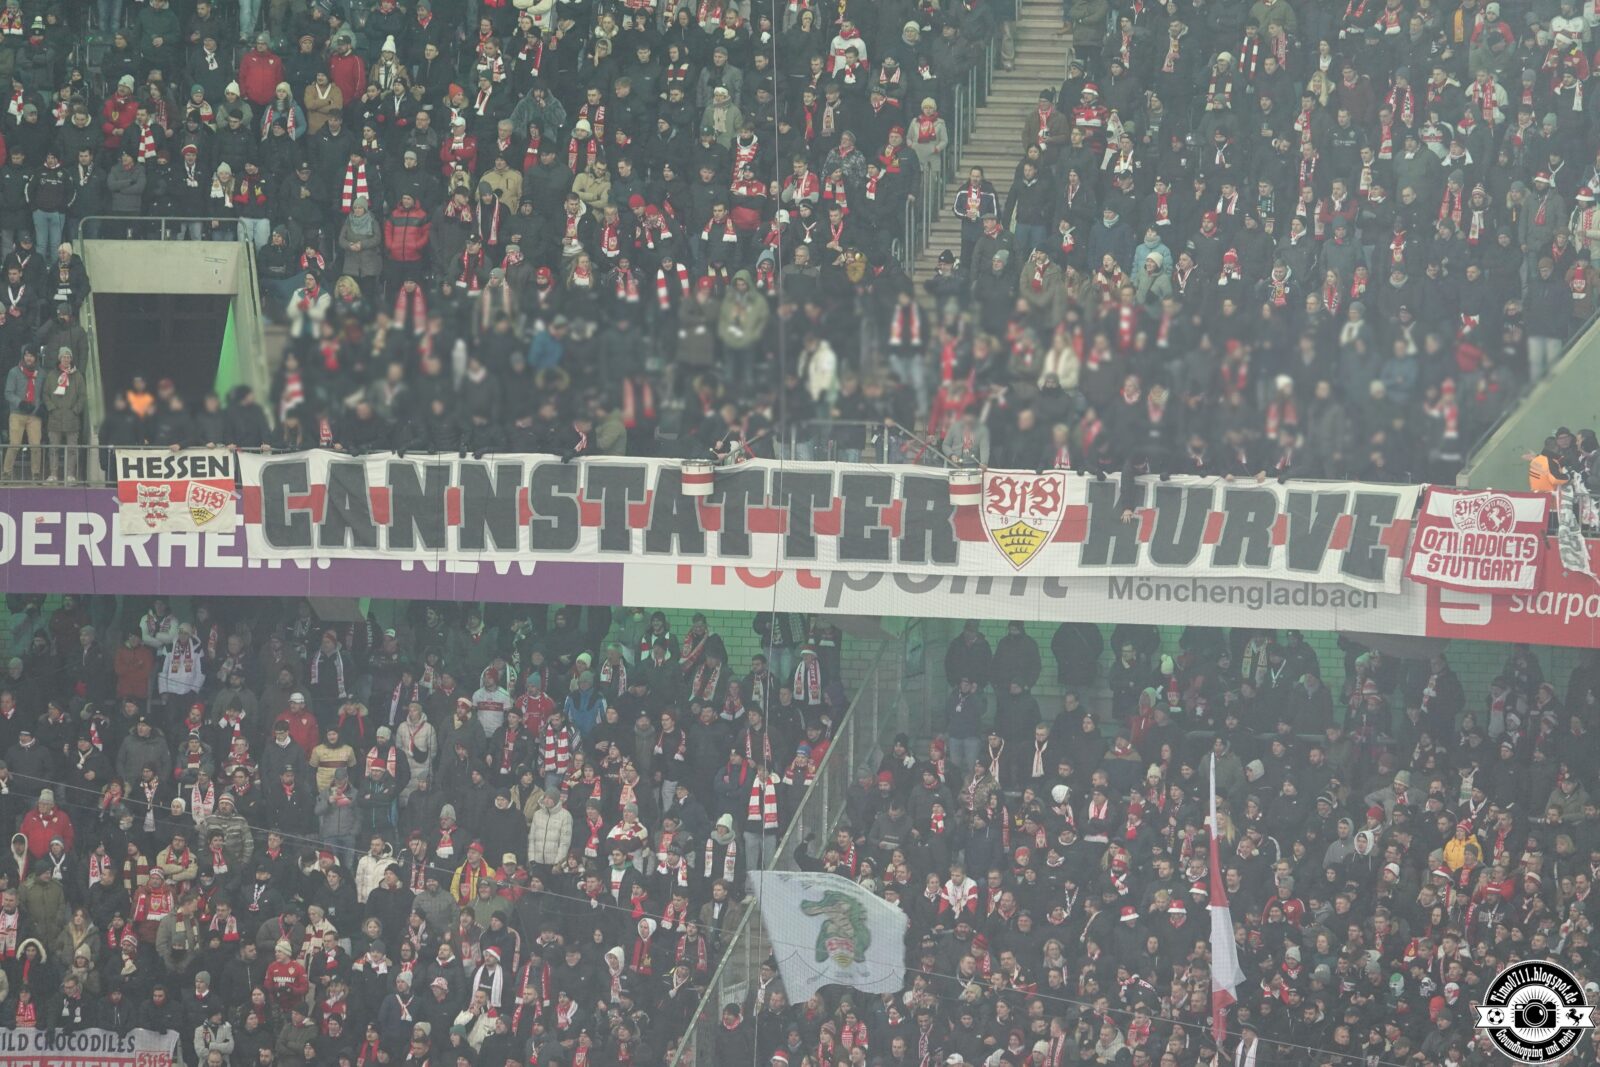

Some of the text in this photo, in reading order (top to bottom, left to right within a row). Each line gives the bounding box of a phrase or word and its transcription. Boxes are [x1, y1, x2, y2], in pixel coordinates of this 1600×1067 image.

[122, 455, 230, 479] HESSEN
[986, 475, 1061, 518] VfB
[260, 458, 1401, 583] CANNSTATTER KURVE
[1423, 528, 1536, 559] 0711 ADDICTS
[1427, 553, 1525, 581] STUTTGART
[0, 1032, 29, 1052] ILD
